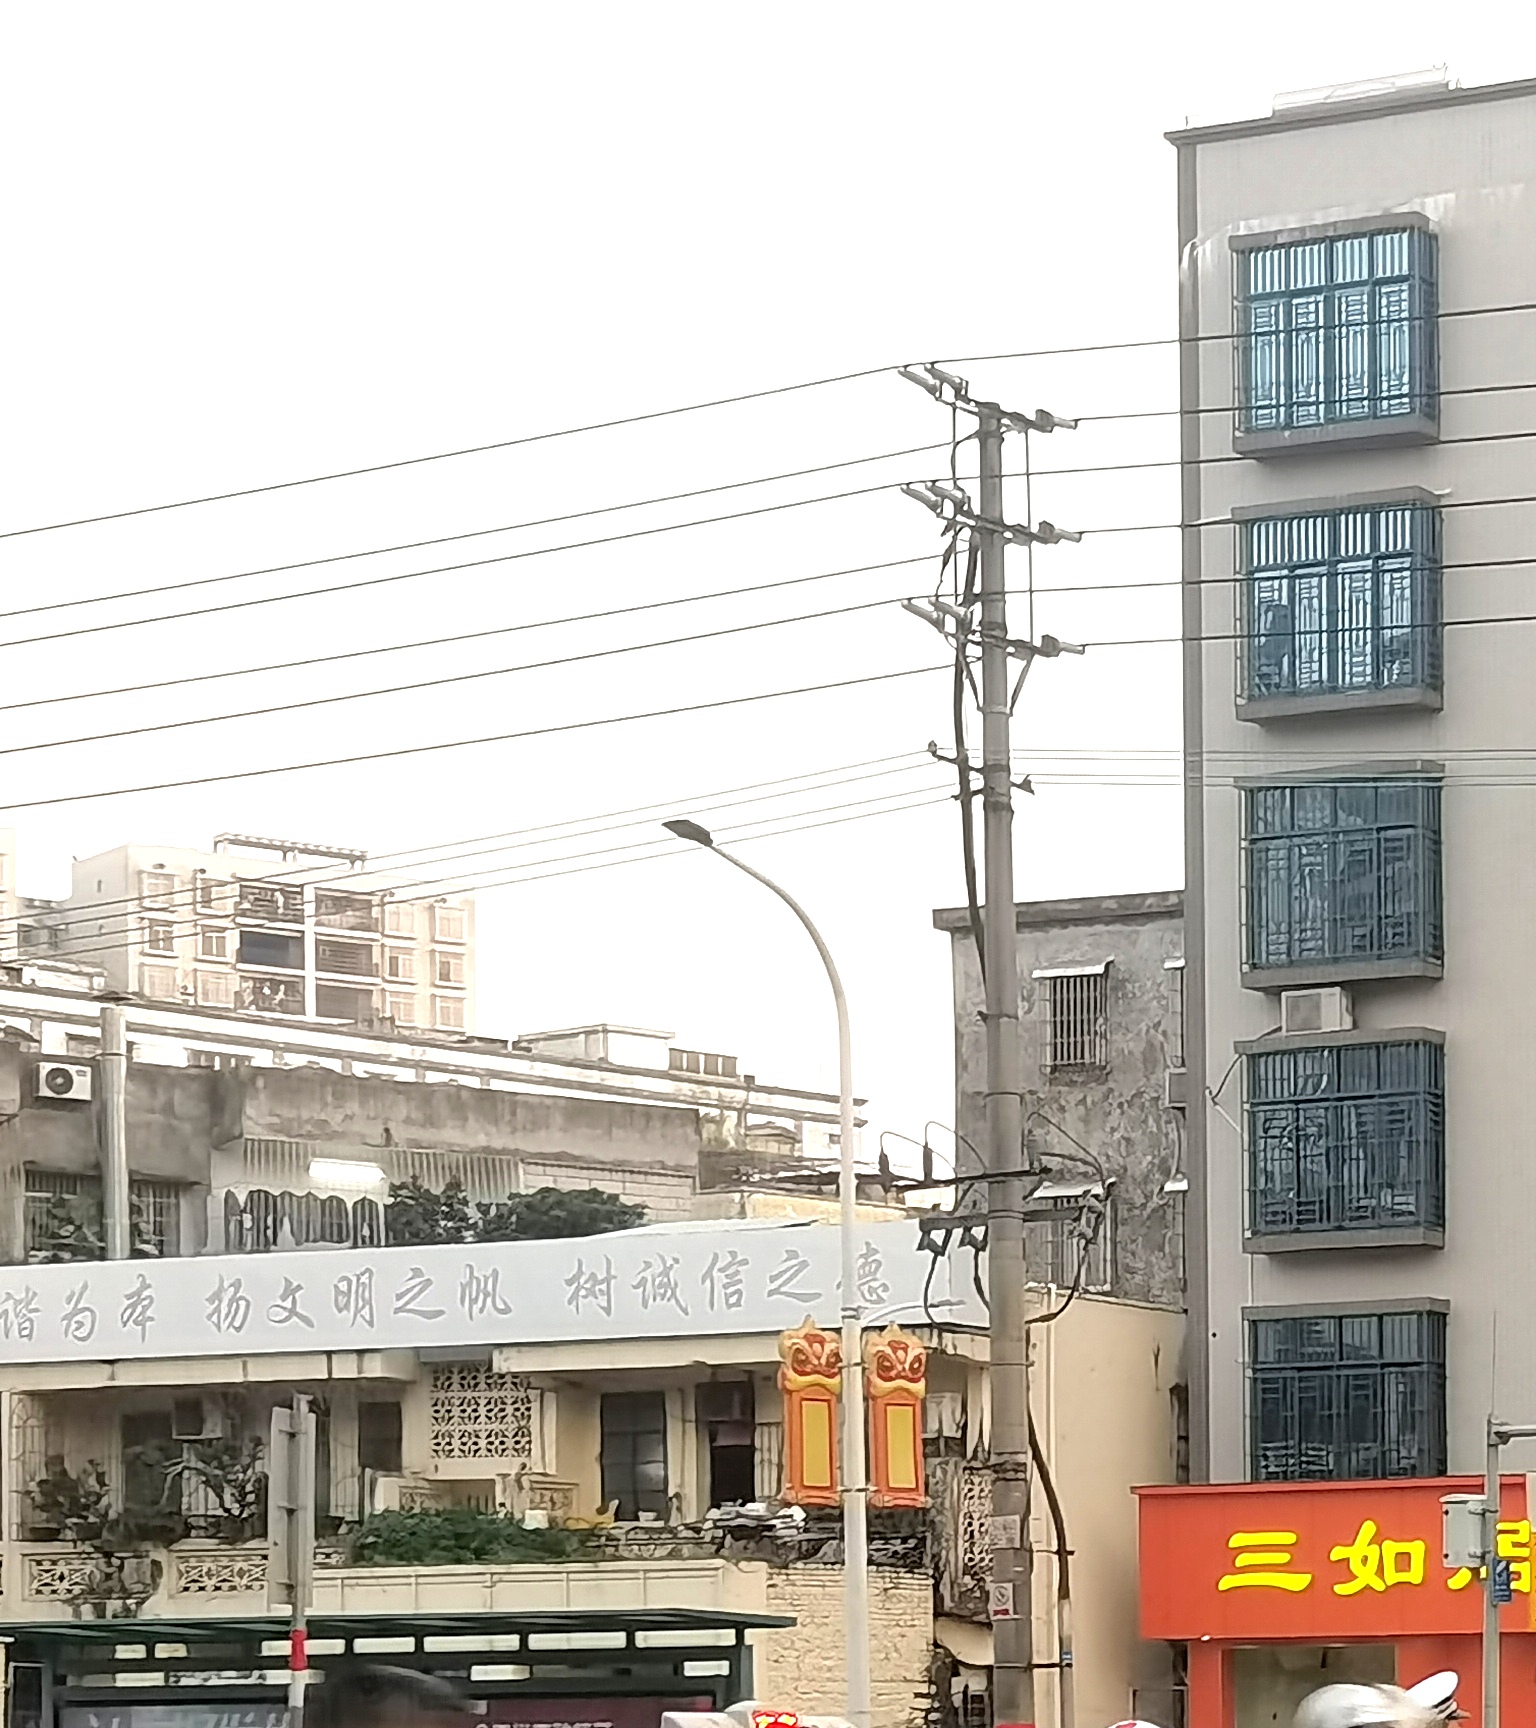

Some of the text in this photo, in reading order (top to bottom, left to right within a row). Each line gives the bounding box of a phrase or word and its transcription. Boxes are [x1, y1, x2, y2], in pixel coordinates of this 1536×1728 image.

[204, 1261, 513, 1335] 扬文明之帆
[563, 1241, 891, 1318] 树诚信之德
